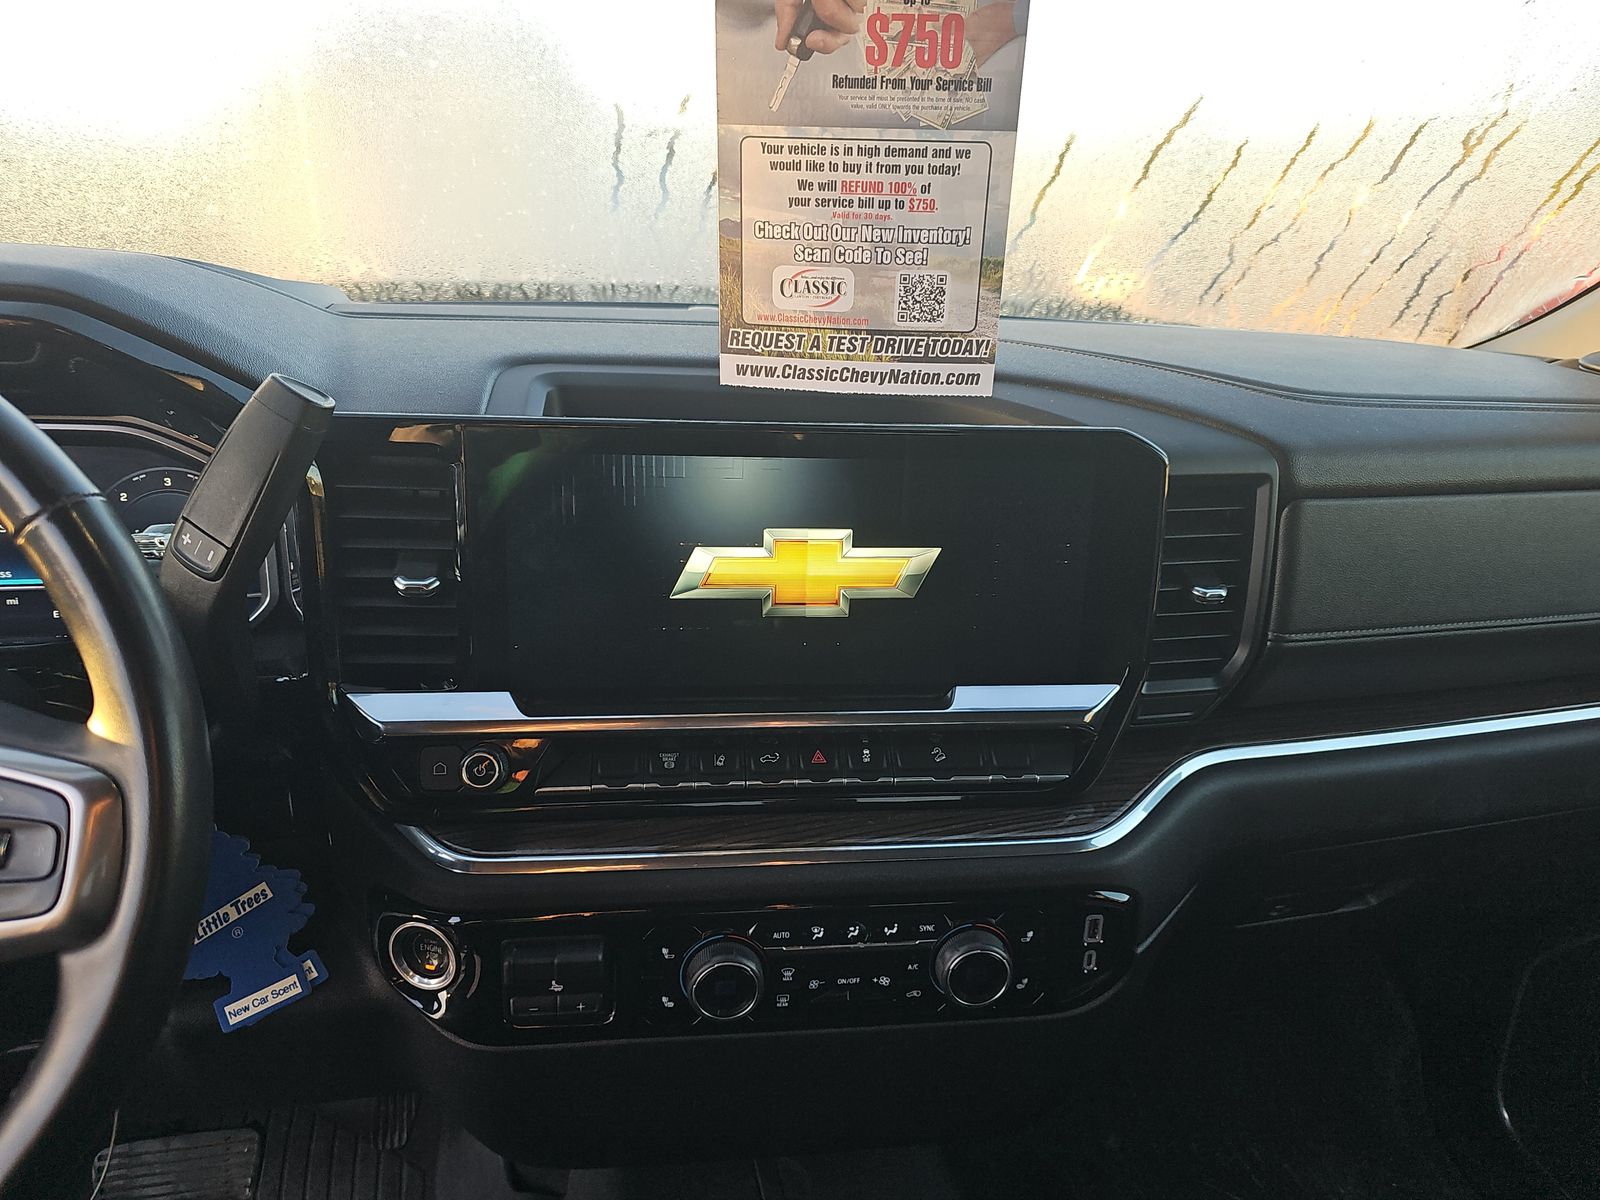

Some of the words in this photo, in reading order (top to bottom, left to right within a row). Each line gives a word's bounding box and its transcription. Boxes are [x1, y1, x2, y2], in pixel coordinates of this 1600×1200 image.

[866, 7, 965, 74] $750
[832, 75, 877, 90] Refunded
[880, 76, 906, 90] From
[910, 77, 932, 91] Your
[936, 77, 973, 92] Service
[976, 78, 992, 92] Bill
[760, 142, 784, 154] Your
[788, 143, 826, 156] vehicle
[830, 144, 839, 156] is
[843, 144, 853, 156] in
[857, 144, 880, 158] high
[884, 145, 928, 158] demand
[932, 146, 951, 159] and
[955, 148, 971, 159] we
[770, 159, 801, 171] would
[805, 160, 825, 172] like
[829, 161, 838, 172] to
[842, 161, 862, 174] buy
[865, 161, 872, 173] it
[876, 162, 901, 174] from
[905, 164, 924, 176] you
[928, 163, 961, 176] today!
[797, 179, 814, 192] We
[818, 180, 837, 192] will
[840, 180, 884, 194] REFUND
[888, 182, 917, 195] 100%
[920, 182, 931, 194] of
[788, 197, 811, 208] your
[814, 196, 854, 208] service
[858, 197, 874, 209] bill
[878, 199, 891, 211] up
[895, 198, 904, 210] to
[908, 197, 938, 212] $750.
[875, 213, 893, 221] days.
[754, 221, 800, 240] Check
[802, 222, 828, 241] Out
[831, 223, 858, 242] Our
[861, 224, 895, 243] New
[897, 225, 972, 247] Inventory!
[794, 244, 831, 262] Scan
[834, 245, 872, 264] Code
[875, 247, 892, 265] To
[895, 247, 928, 265] See!
[780, 278, 848, 298] CLASSIC
[756, 312, 869, 326] www.ClassicChevyNation.com
[728, 329, 807, 352] REQUEST
[808, 334, 821, 352] A
[827, 335, 870, 354] TEST
[872, 337, 926, 355] DRIVE
[929, 338, 991, 356] TODAY!
[736, 363, 981, 385] www.ClassicChevyNation.com
[164, 478, 171, 486] 3
[120, 493, 128, 501] 2
[6, 597, 19, 605] mi
[230, 888, 268, 916] Trees
[228, 1002, 250, 1019] New
[252, 994, 269, 1008] Car
[271, 981, 298, 1000] Scent
